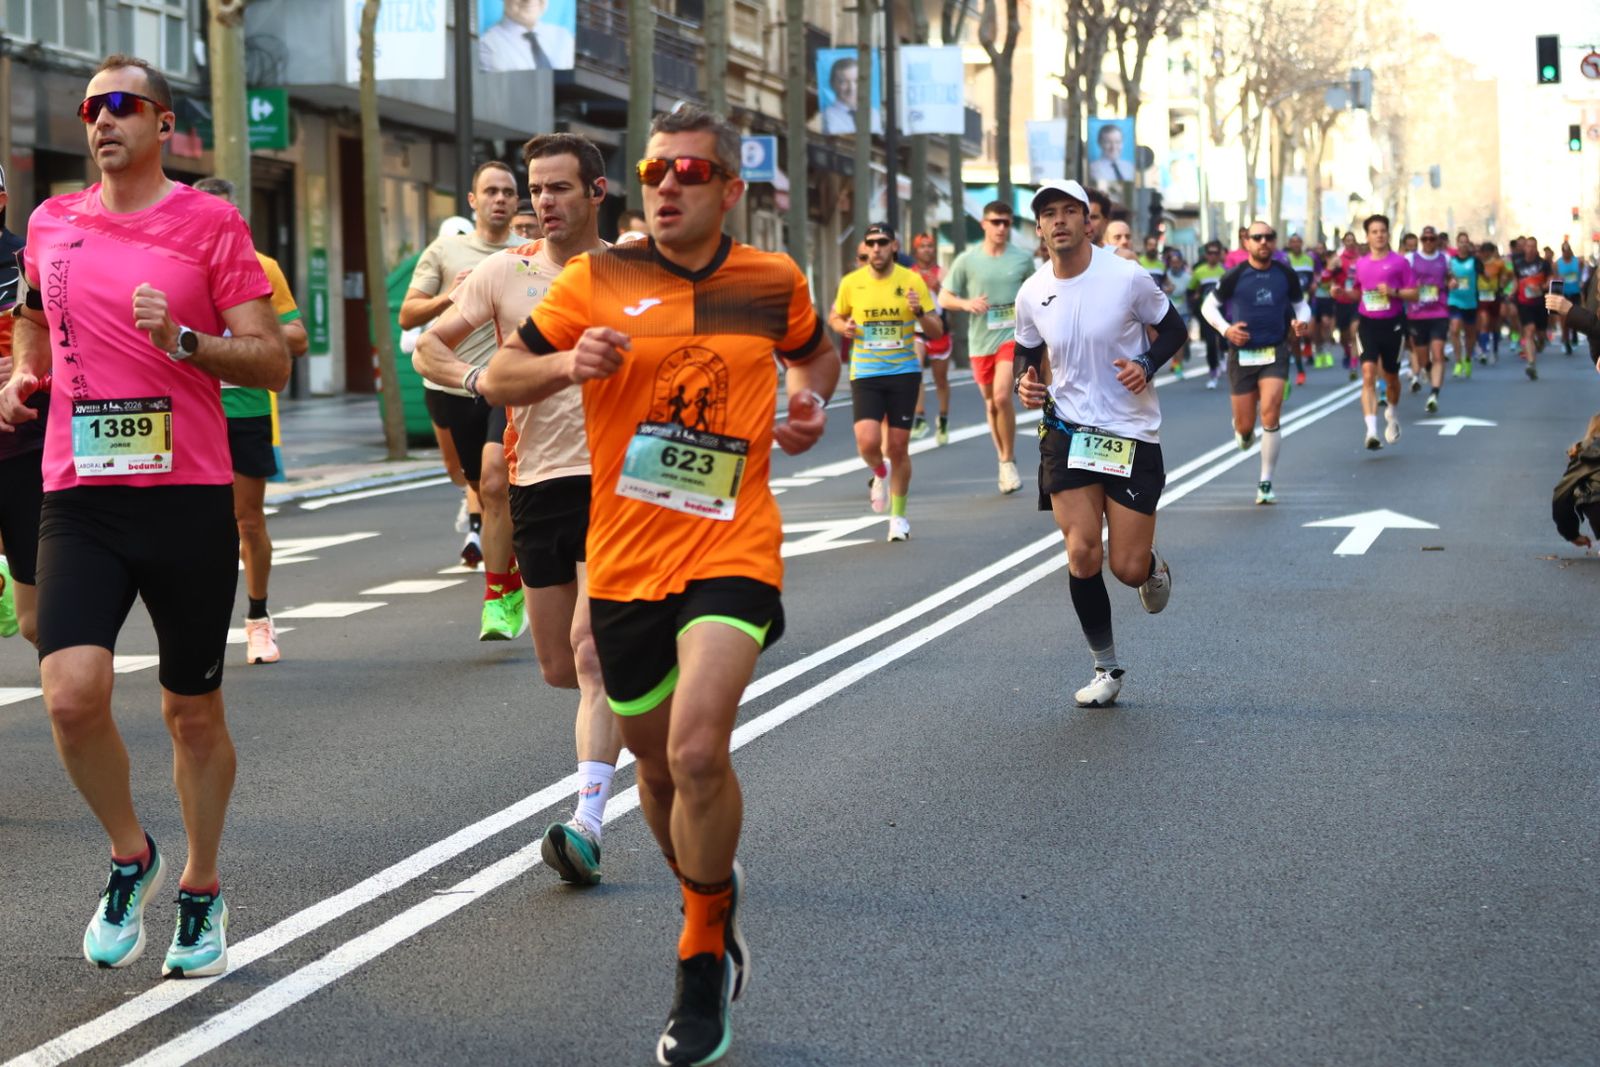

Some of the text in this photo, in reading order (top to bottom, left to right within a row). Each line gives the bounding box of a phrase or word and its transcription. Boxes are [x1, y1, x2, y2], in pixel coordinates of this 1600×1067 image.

[47, 259, 64, 311] 2024
[62, 260, 70, 304] SALAMANCA
[863, 308, 900, 318] TEAM
[872, 327, 897, 336] 2125
[124, 401, 143, 411] 2026
[90, 417, 153, 439] 1389
[1084, 436, 1123, 453] 1743
[660, 446, 715, 476] 623
